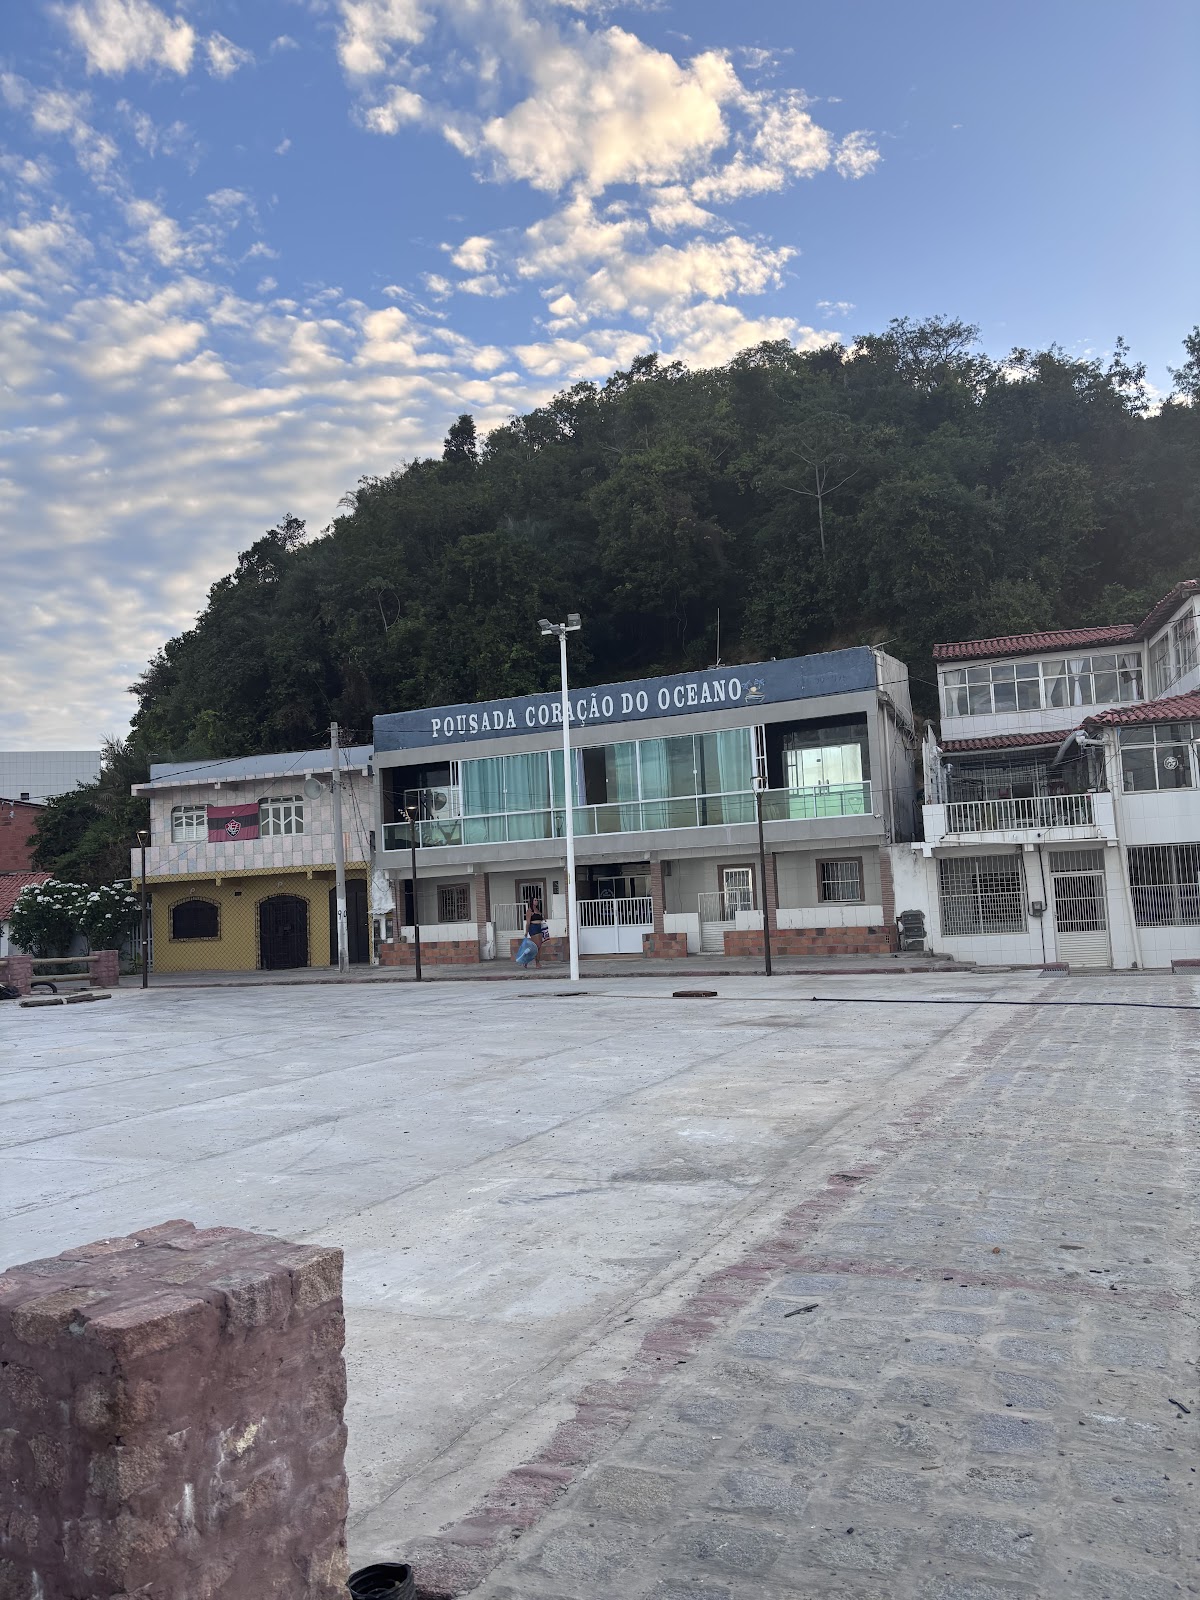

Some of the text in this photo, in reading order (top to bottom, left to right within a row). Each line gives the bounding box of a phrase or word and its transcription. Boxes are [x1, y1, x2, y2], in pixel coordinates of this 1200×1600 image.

[431, 678, 741, 738] POUSADA CORAÇÃO DO OCEANO
